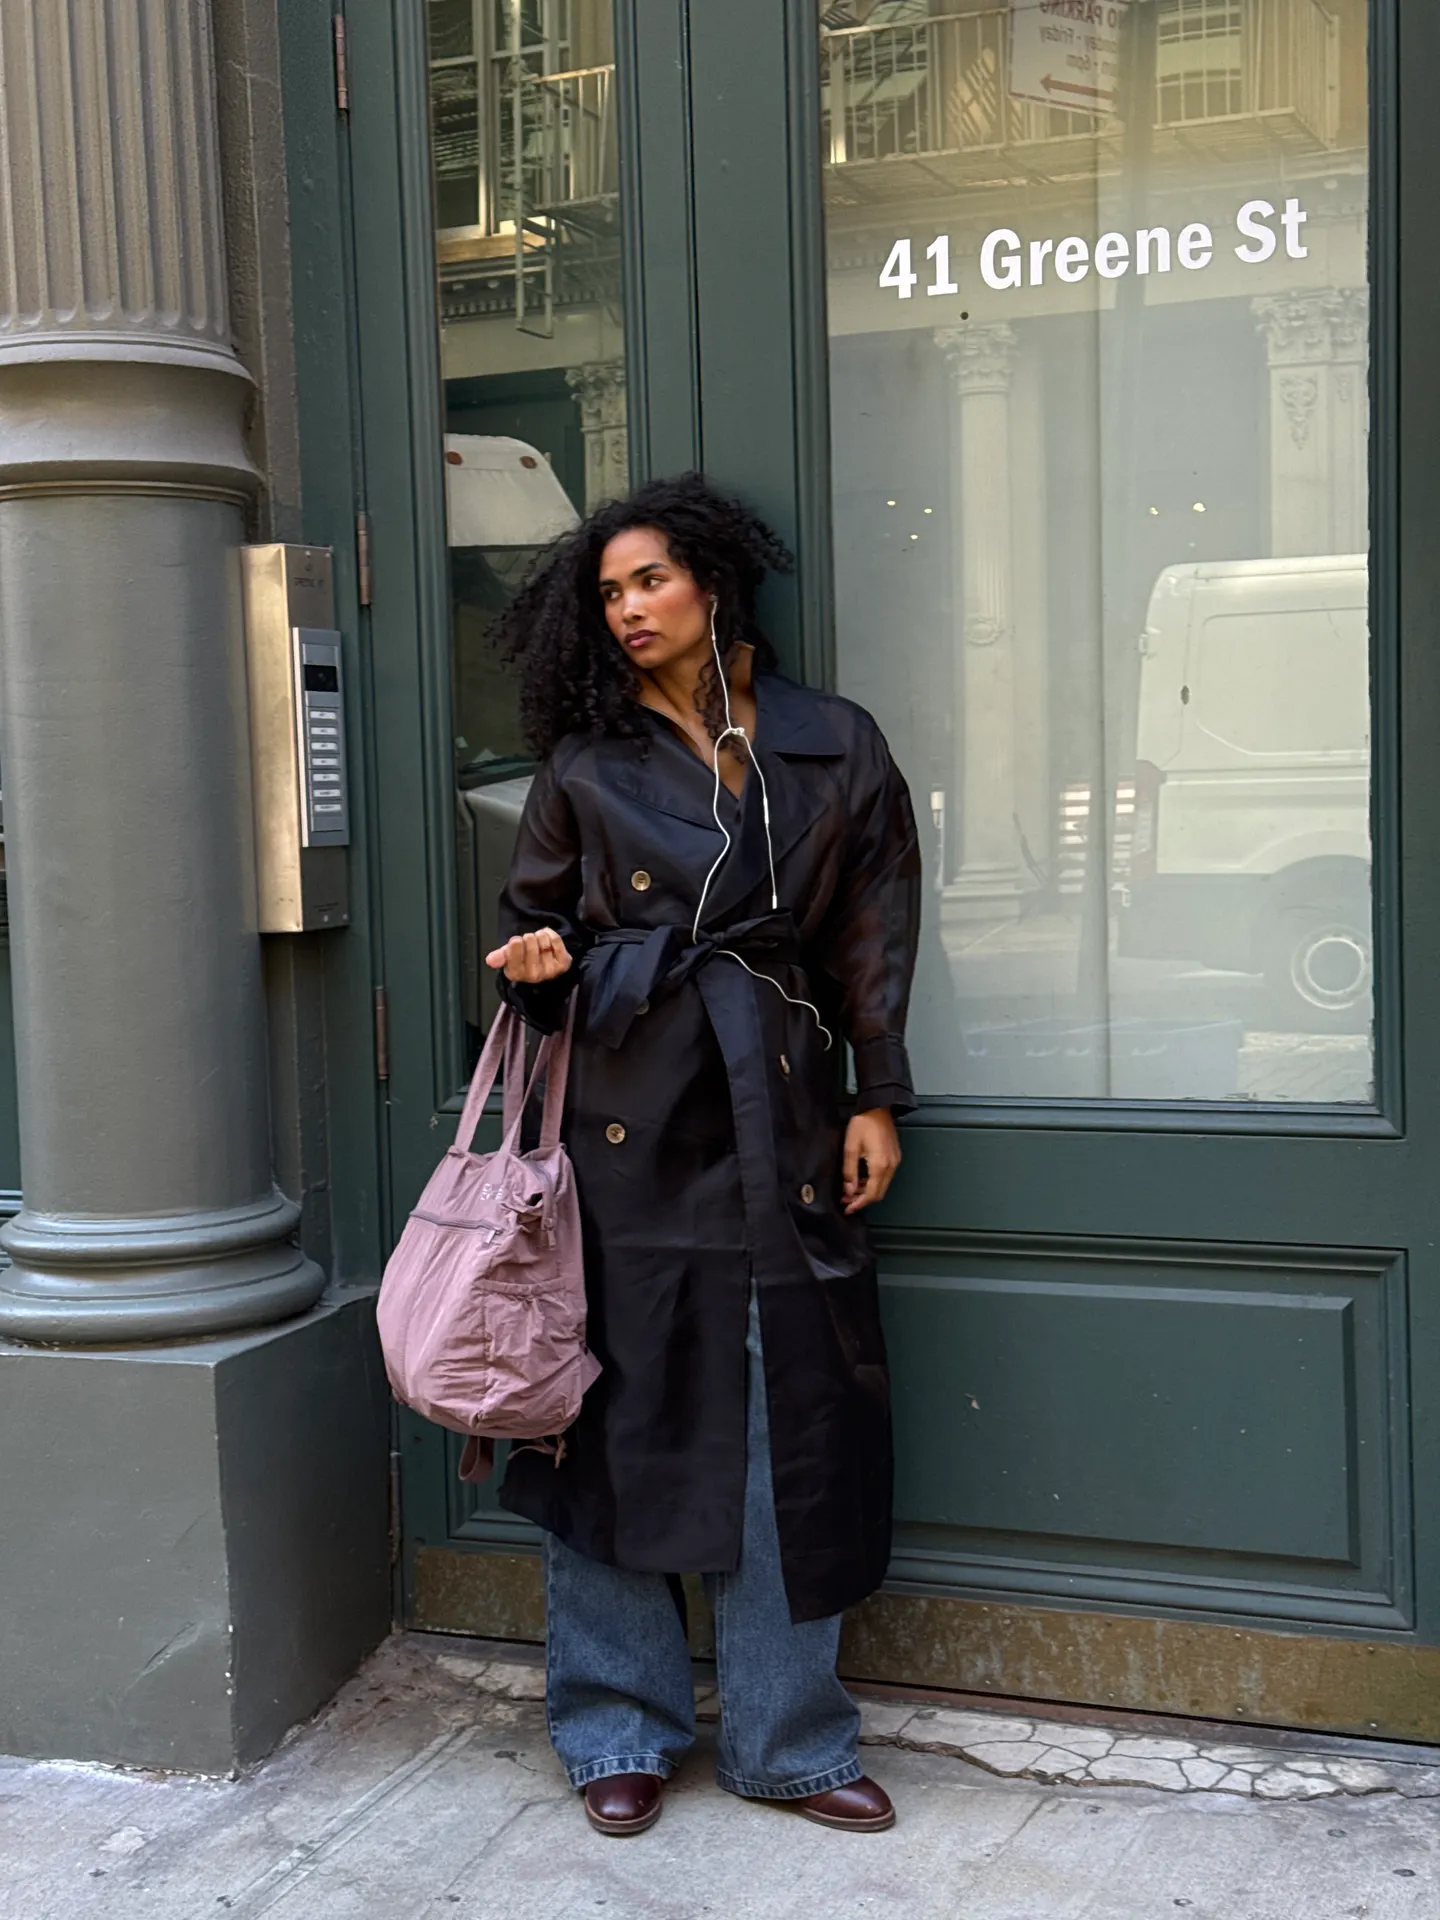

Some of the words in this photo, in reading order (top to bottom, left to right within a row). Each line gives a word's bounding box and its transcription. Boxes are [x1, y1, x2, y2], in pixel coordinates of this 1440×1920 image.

[879, 235, 959, 299] 41
[980, 222, 1214, 291] Greene
[1234, 198, 1309, 264] St
